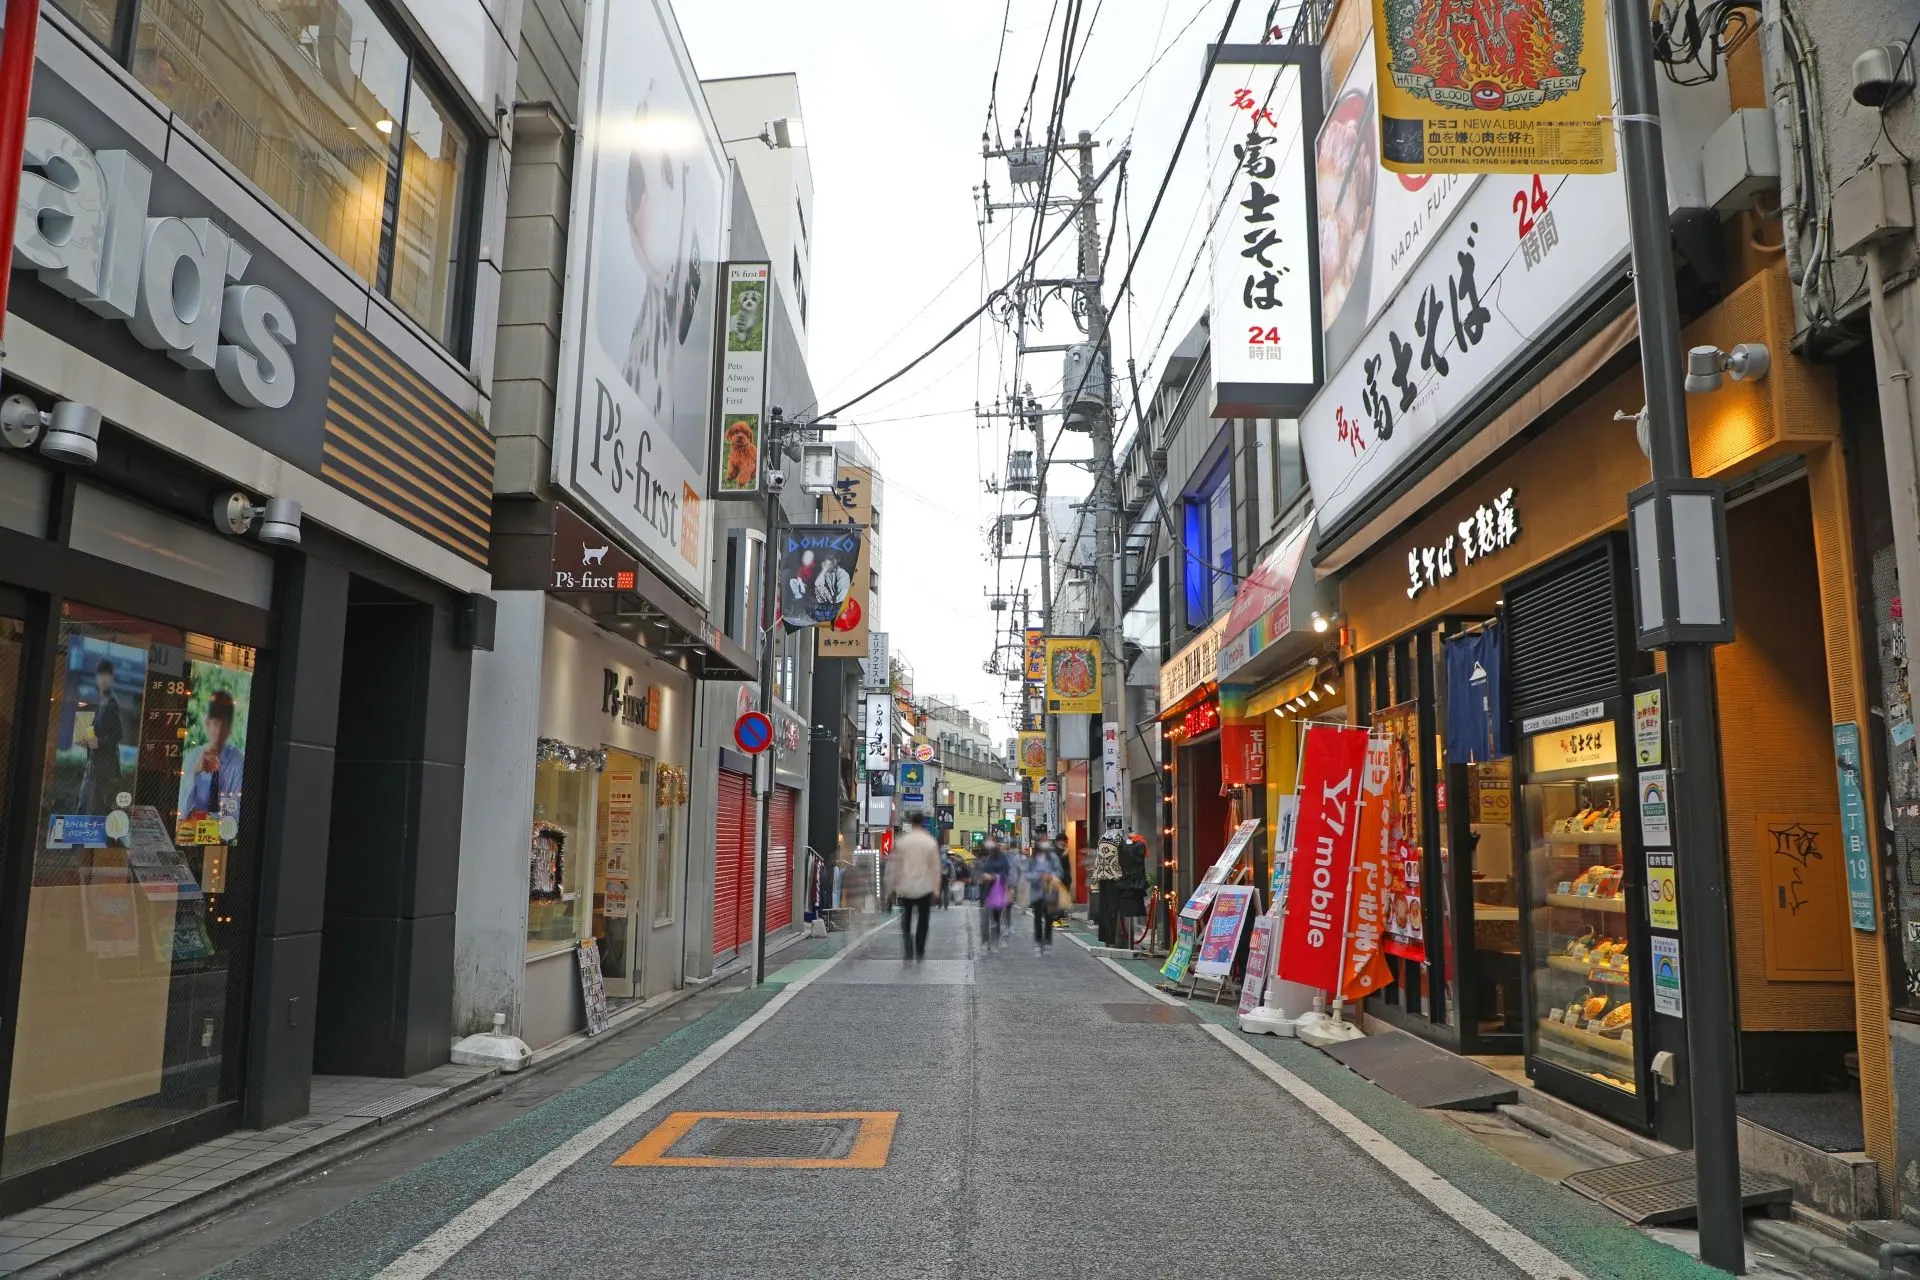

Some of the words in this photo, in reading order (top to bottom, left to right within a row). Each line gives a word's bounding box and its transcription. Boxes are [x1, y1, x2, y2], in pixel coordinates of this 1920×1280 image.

[1397, 72, 1421, 86] HATE
[1546, 78, 1578, 90] FLESH
[1434, 89, 1470, 102] BLOOD
[1506, 91, 1535, 103] LOVE
[1229, 88, 1278, 128] 名代
[1428, 120, 1458, 129] ドミコ
[1463, 119, 1493, 129] NEW
[1493, 120, 1534, 130] ALBUM
[1428, 131, 1535, 144] 血を嫌い肉を好む
[1428, 146, 1456, 157] OUT
[1512, 174, 1549, 240] 24
[1233, 131, 1290, 310] 富士そば
[1391, 212, 1423, 272] NADAI
[1521, 209, 1559, 273] 時間
[1249, 326, 1281, 345] 24
[1335, 404, 1366, 457] 名代
[1362, 221, 1491, 442] 富士そば
[1249, 346, 1282, 361] 時間
[727, 363, 743, 371] Pets
[727, 374, 755, 384] Always
[590, 376, 679, 549] P's-first
[788, 536, 854, 552] DOMICO
[555, 571, 615, 588] P's-first
[166, 681, 185, 695] 38
[602, 668, 648, 726] P's-first
[166, 712, 183, 725] 77
[1570, 729, 1603, 754] 富士そば
[164, 744, 179, 757] 12
[1842, 748, 1861, 852] 北沢二丁目
[1649, 855, 1673, 867] 店内禁煙
[1850, 858, 1867, 880] 19
[1307, 836, 1335, 948] mobile
